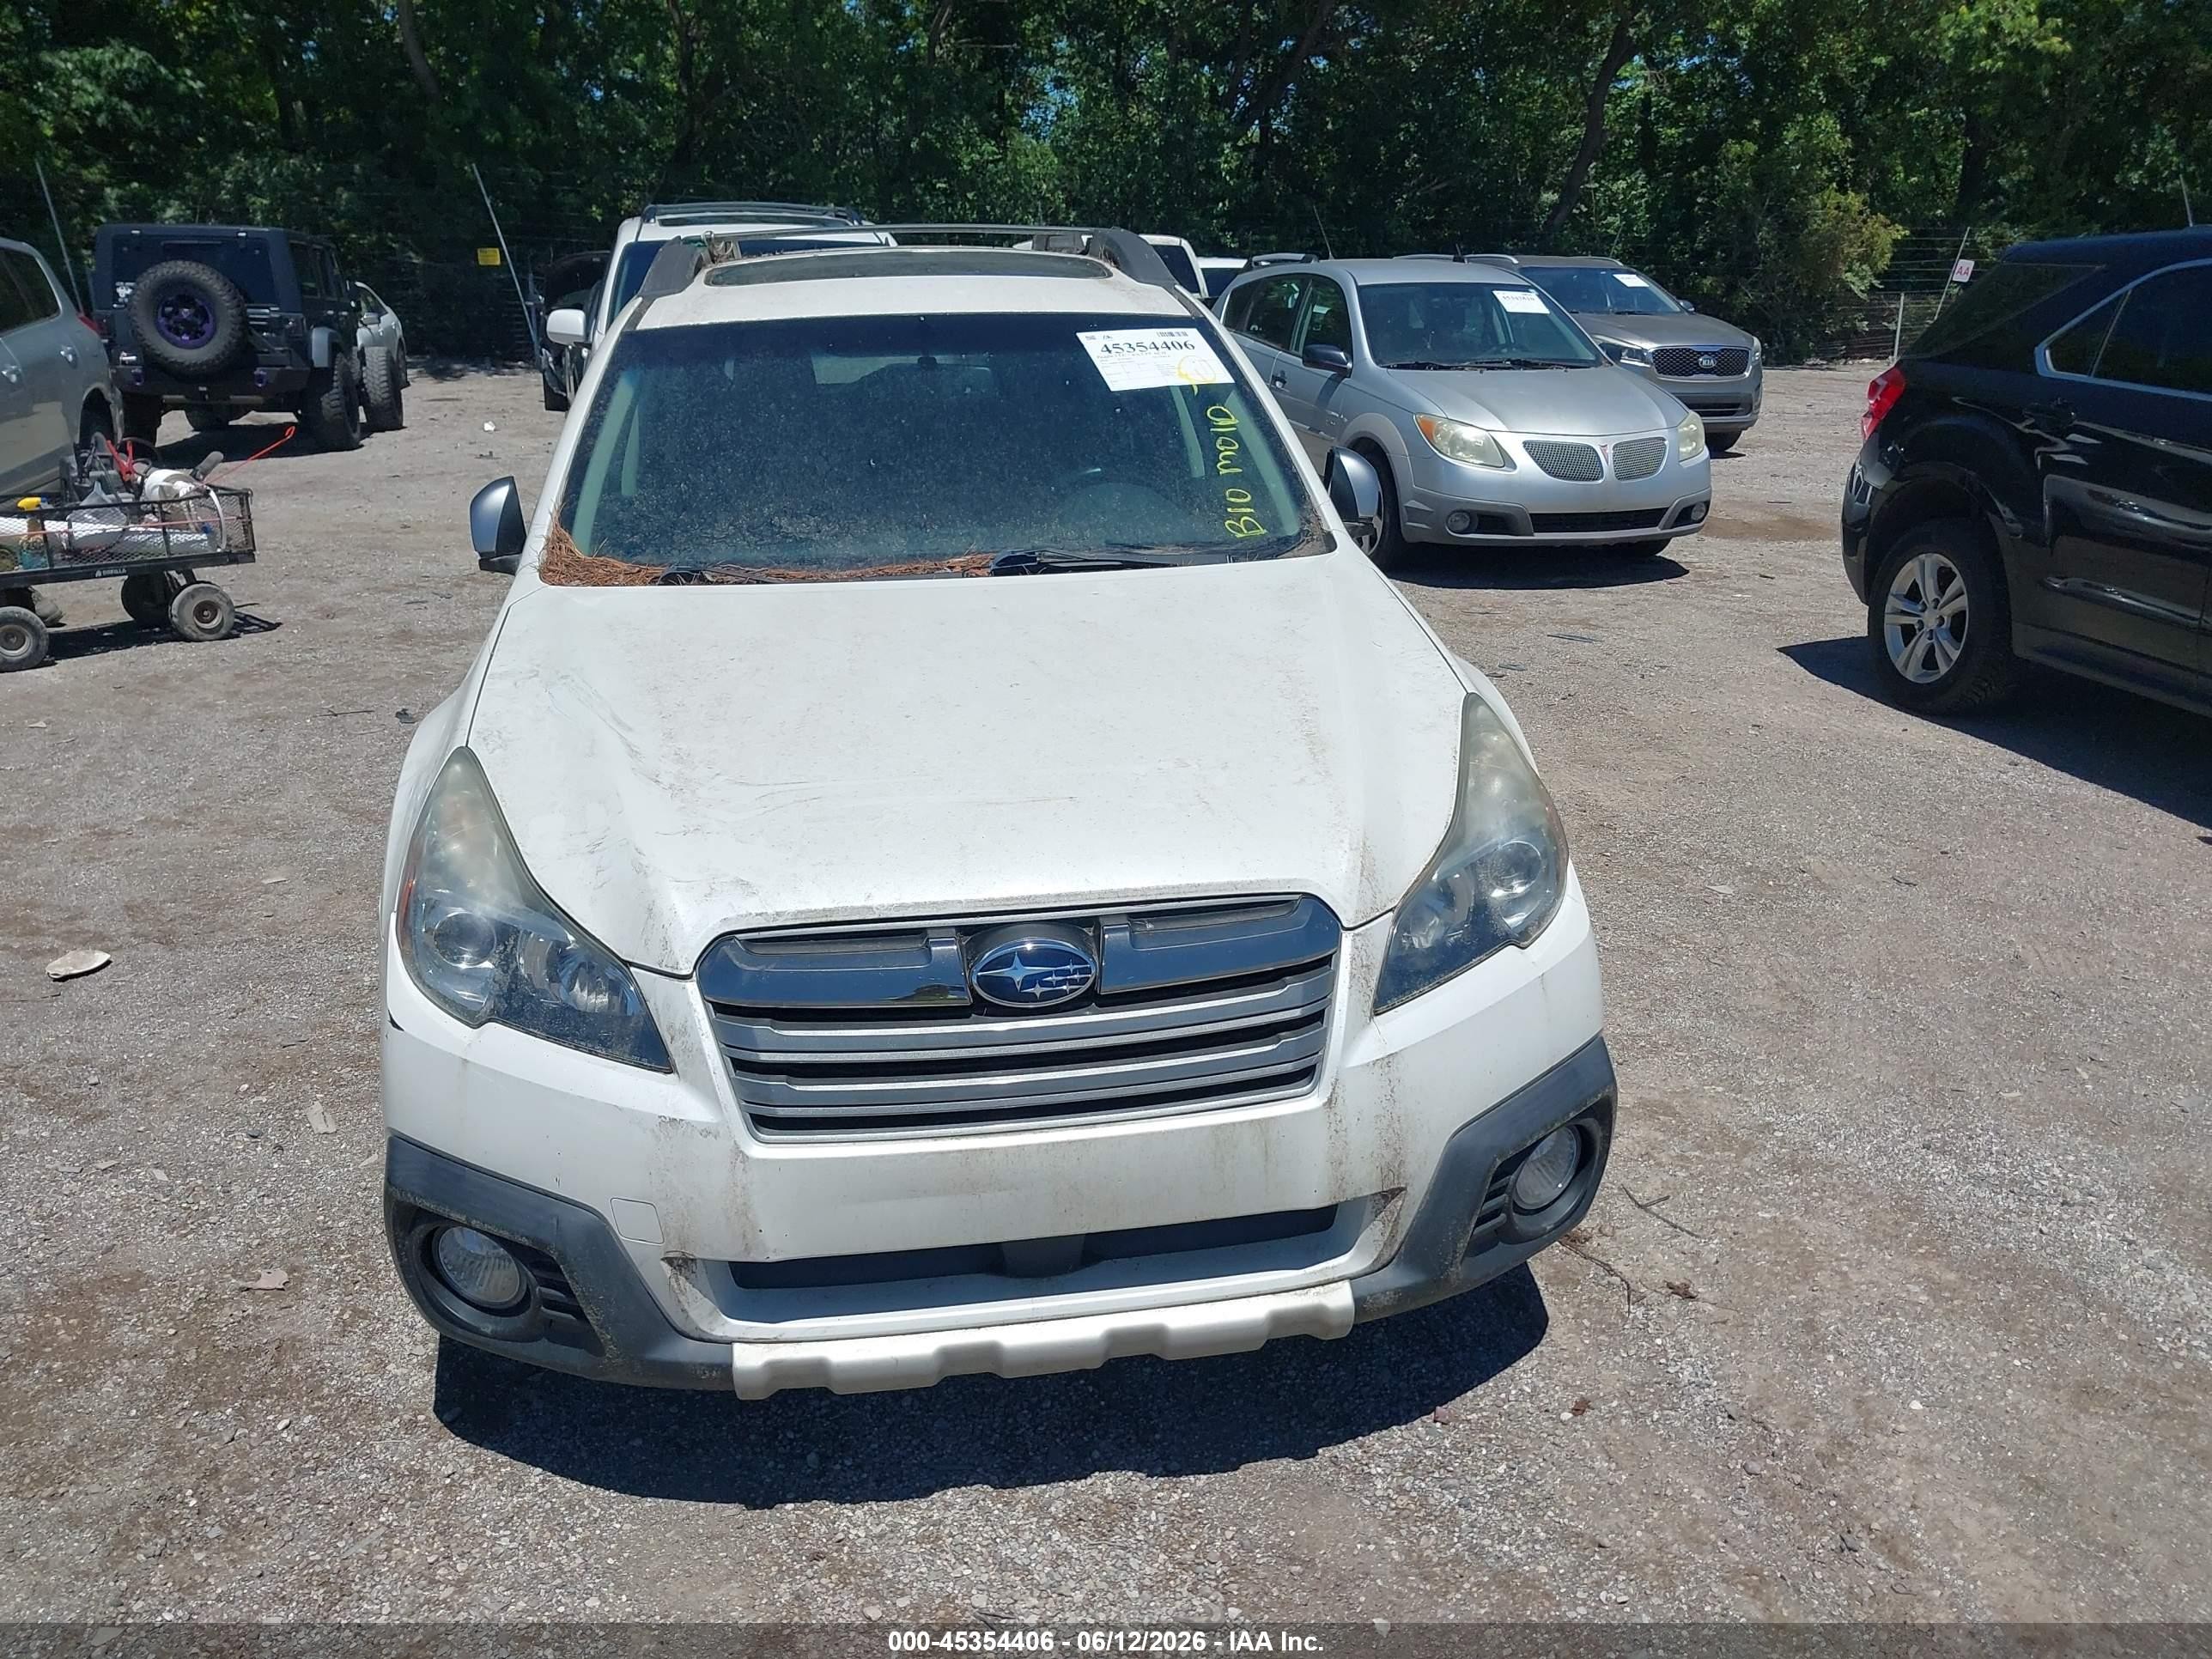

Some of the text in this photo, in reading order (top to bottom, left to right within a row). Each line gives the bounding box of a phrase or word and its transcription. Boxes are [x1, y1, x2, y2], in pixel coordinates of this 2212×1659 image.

[1100, 339, 1196, 355] 45354406
[1701, 358, 1716, 367] KIA
[1224, 489, 1267, 538] BIO
